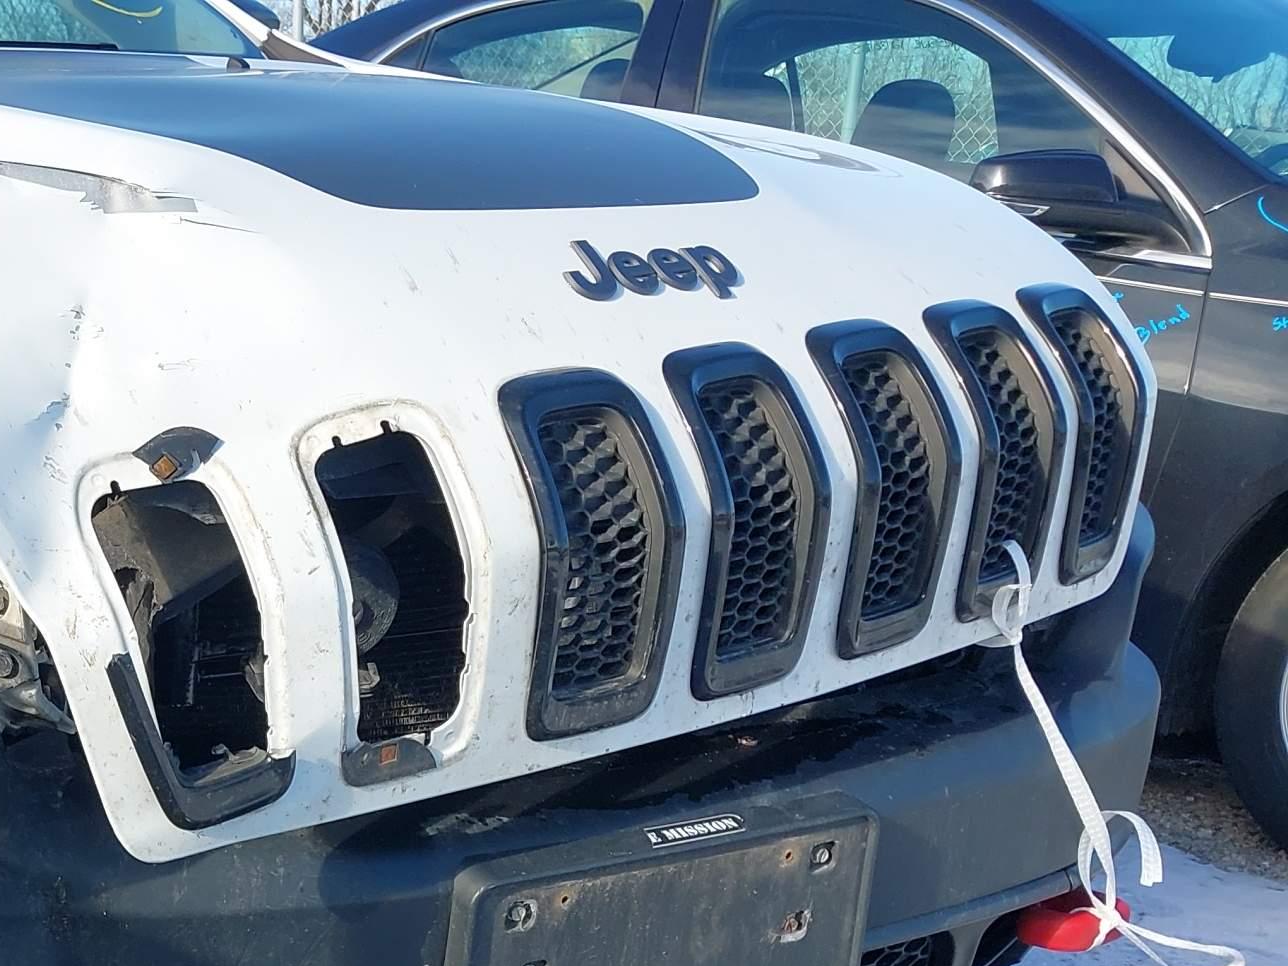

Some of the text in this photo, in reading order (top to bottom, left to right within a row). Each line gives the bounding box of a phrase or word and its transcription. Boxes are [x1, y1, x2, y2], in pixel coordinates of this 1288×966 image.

[562, 240, 739, 302] Jeep
[1134, 304, 1191, 345] Blend
[661, 817, 739, 841] MISSION
